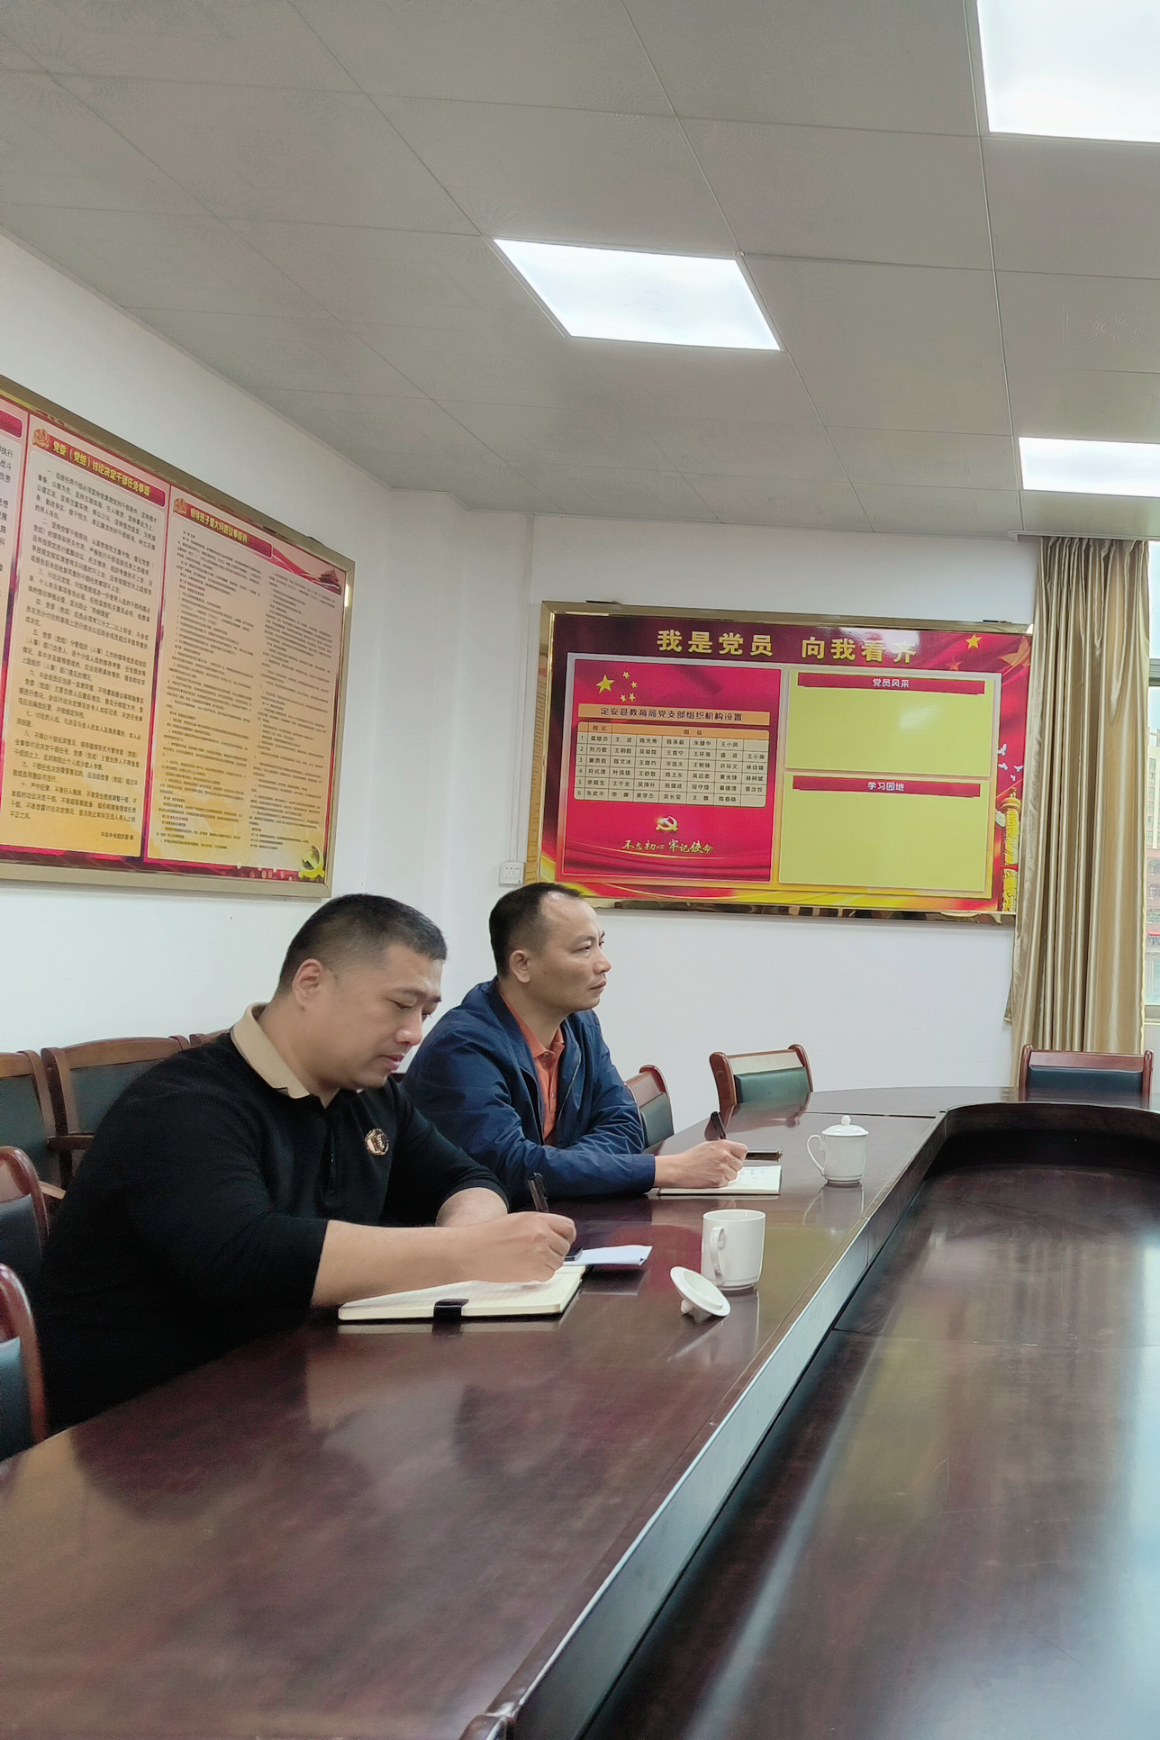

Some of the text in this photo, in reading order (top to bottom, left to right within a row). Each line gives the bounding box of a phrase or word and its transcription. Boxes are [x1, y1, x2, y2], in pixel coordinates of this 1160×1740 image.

[657, 629, 918, 663] 我是党员 向我看齐
[872, 678, 910, 689] 党员风采
[867, 780, 905, 792] 学习园地
[622, 839, 713, 854] 不忘初心 牢记使命
